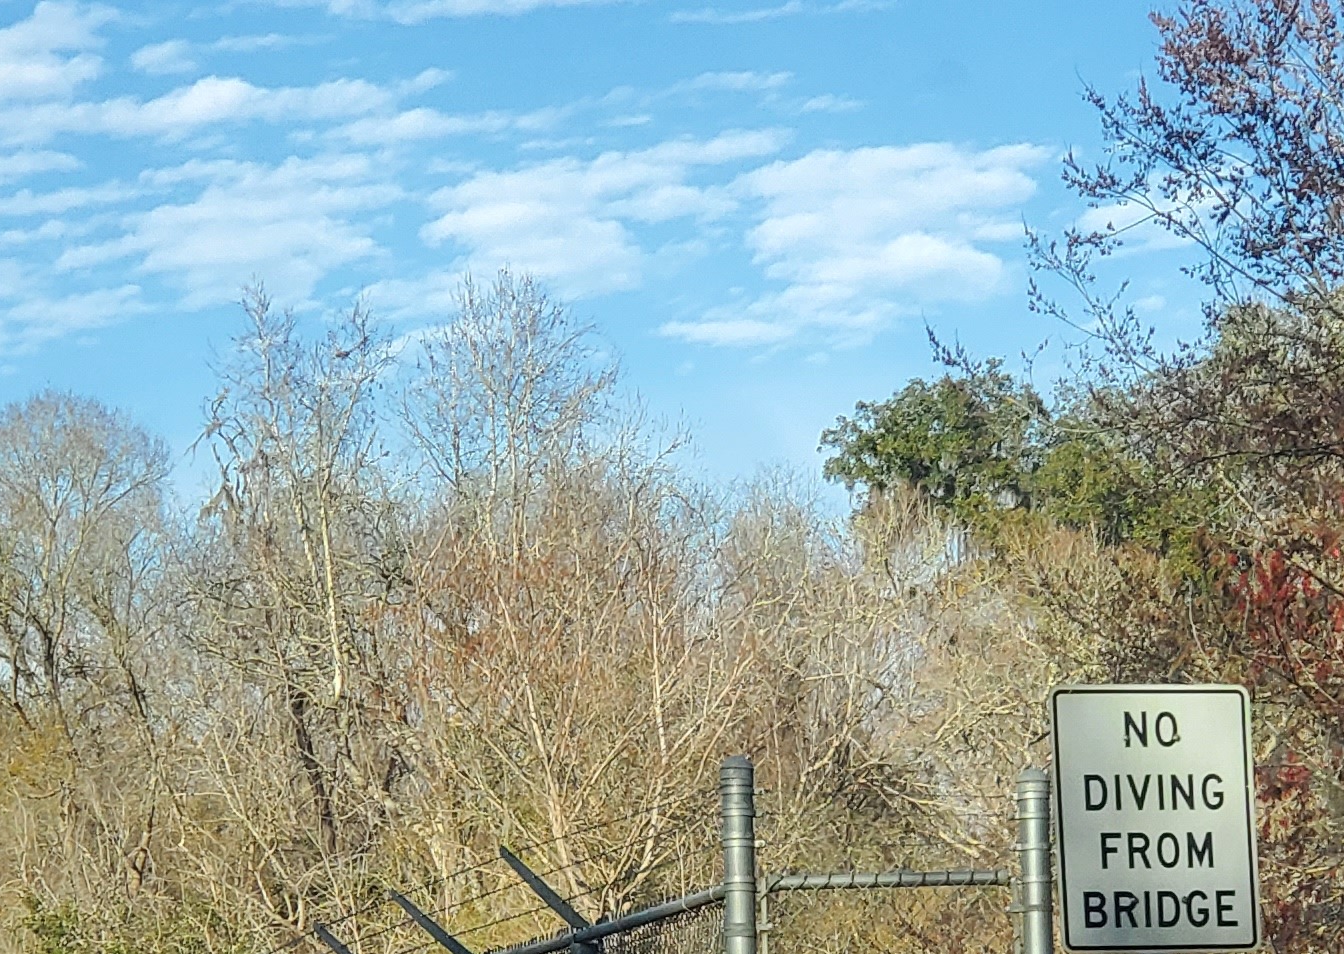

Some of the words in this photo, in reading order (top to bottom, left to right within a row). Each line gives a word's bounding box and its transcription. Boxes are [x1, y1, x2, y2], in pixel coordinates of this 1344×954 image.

[1123, 711, 1179, 747] NO
[1083, 773, 1225, 811] DIVING
[1100, 831, 1214, 869] FROM
[1083, 890, 1239, 928] BRIDGE
